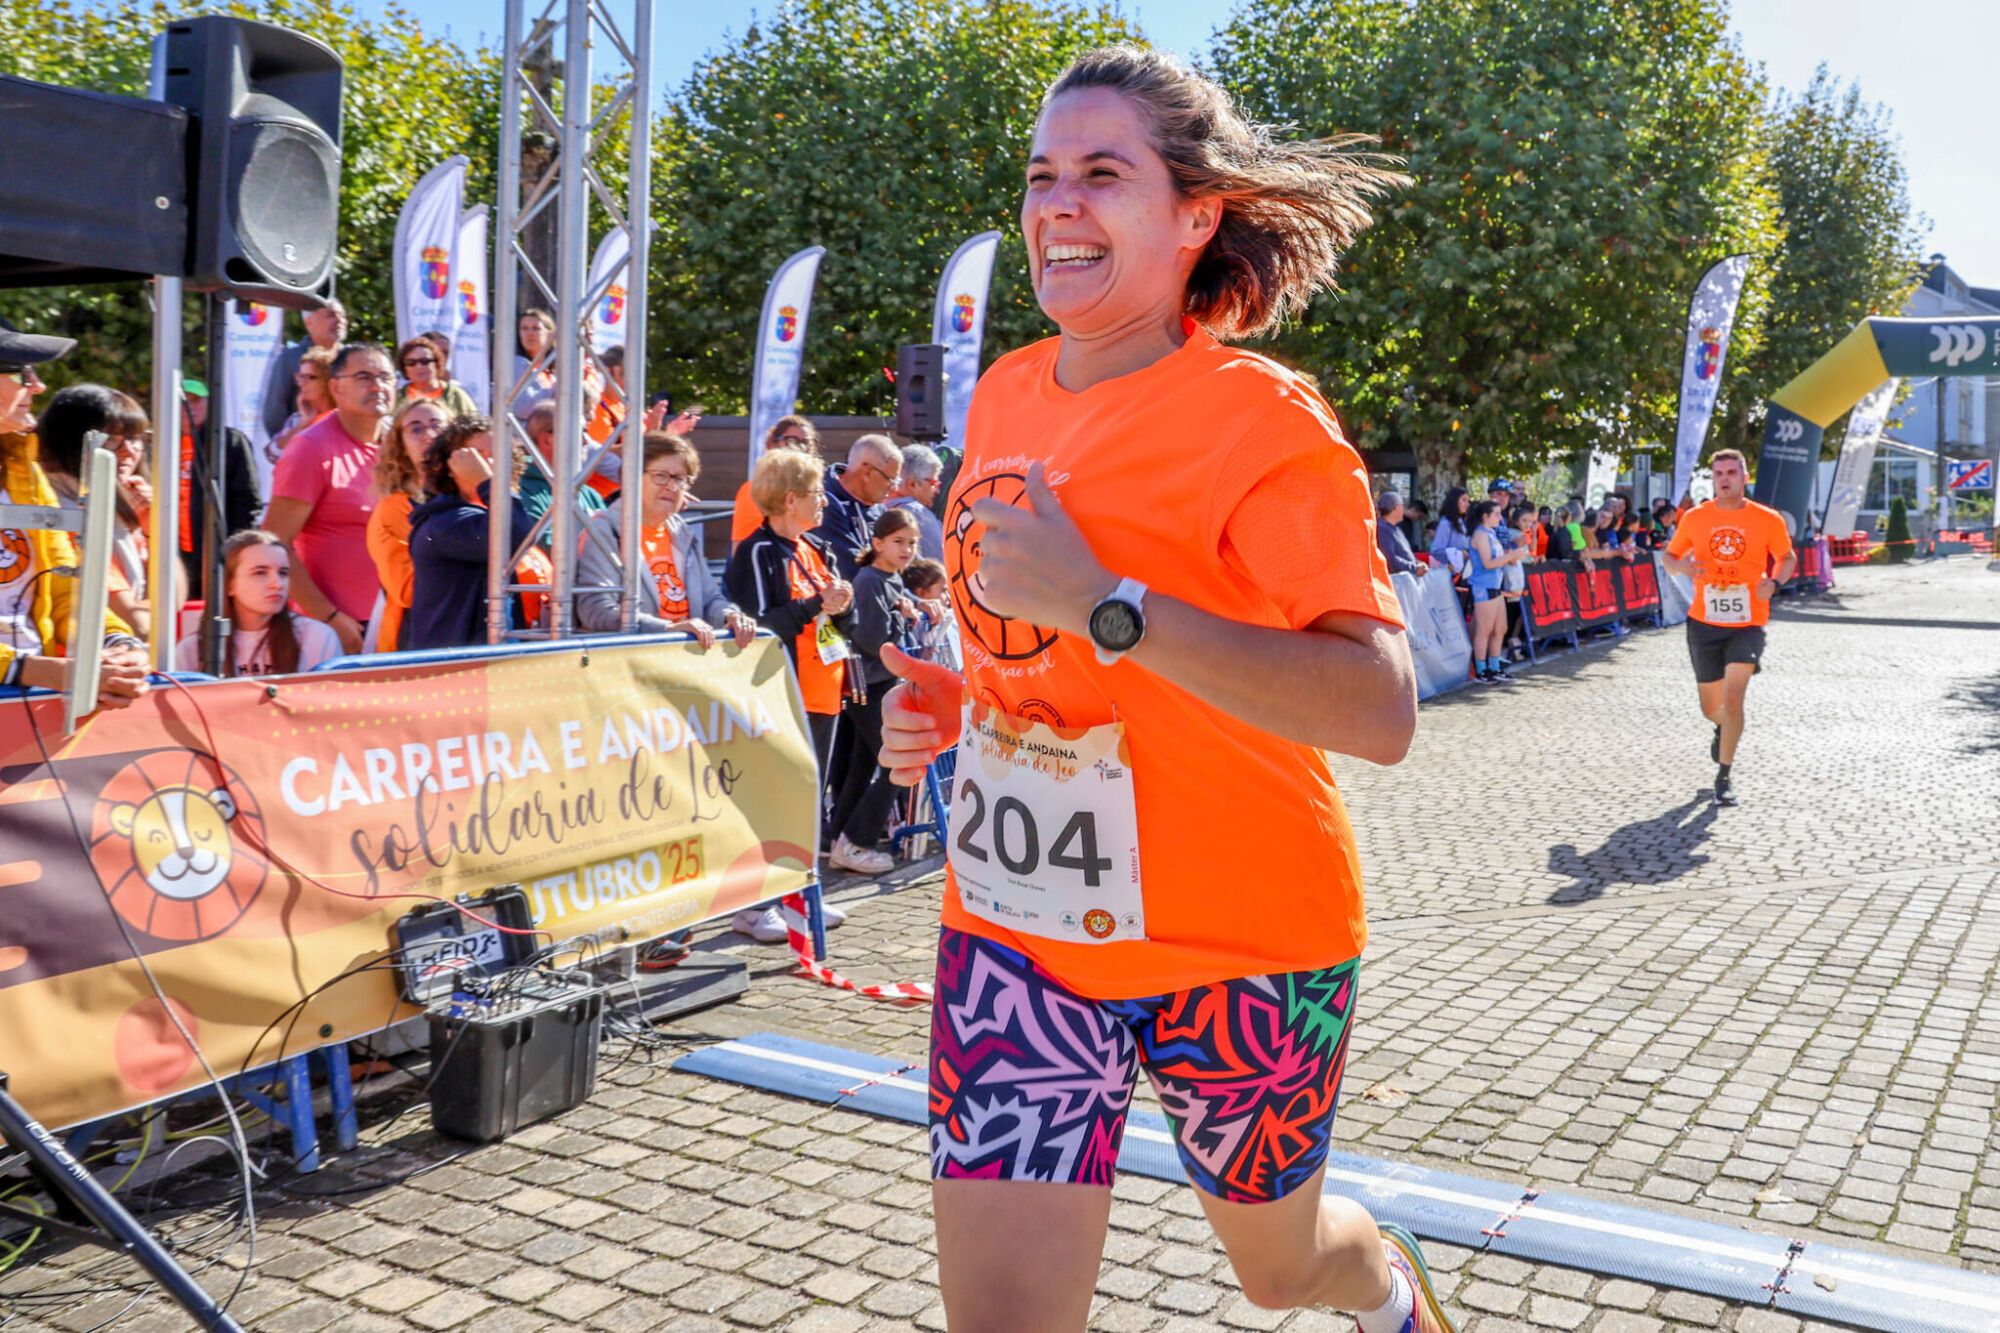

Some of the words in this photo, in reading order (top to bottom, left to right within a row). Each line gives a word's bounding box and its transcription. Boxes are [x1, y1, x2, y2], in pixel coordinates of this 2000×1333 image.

[1711, 598, 1743, 613] 155
[280, 727, 551, 816] CARREIRA
[560, 720, 587, 770] E
[597, 697, 781, 764] ANDAINA
[981, 739, 1029, 768] solidaria
[1033, 755, 1051, 773] de
[1055, 758, 1078, 783] Leo
[982, 724, 1018, 747] CARREIRA
[1019, 738, 1025, 750] E
[1026, 741, 1078, 760] ANDAINA
[350, 771, 605, 897] solidaria
[619, 746, 674, 820] de
[690, 741, 743, 824] Leo
[957, 778, 1112, 887] 204
[530, 851, 662, 925] UTUBRO
